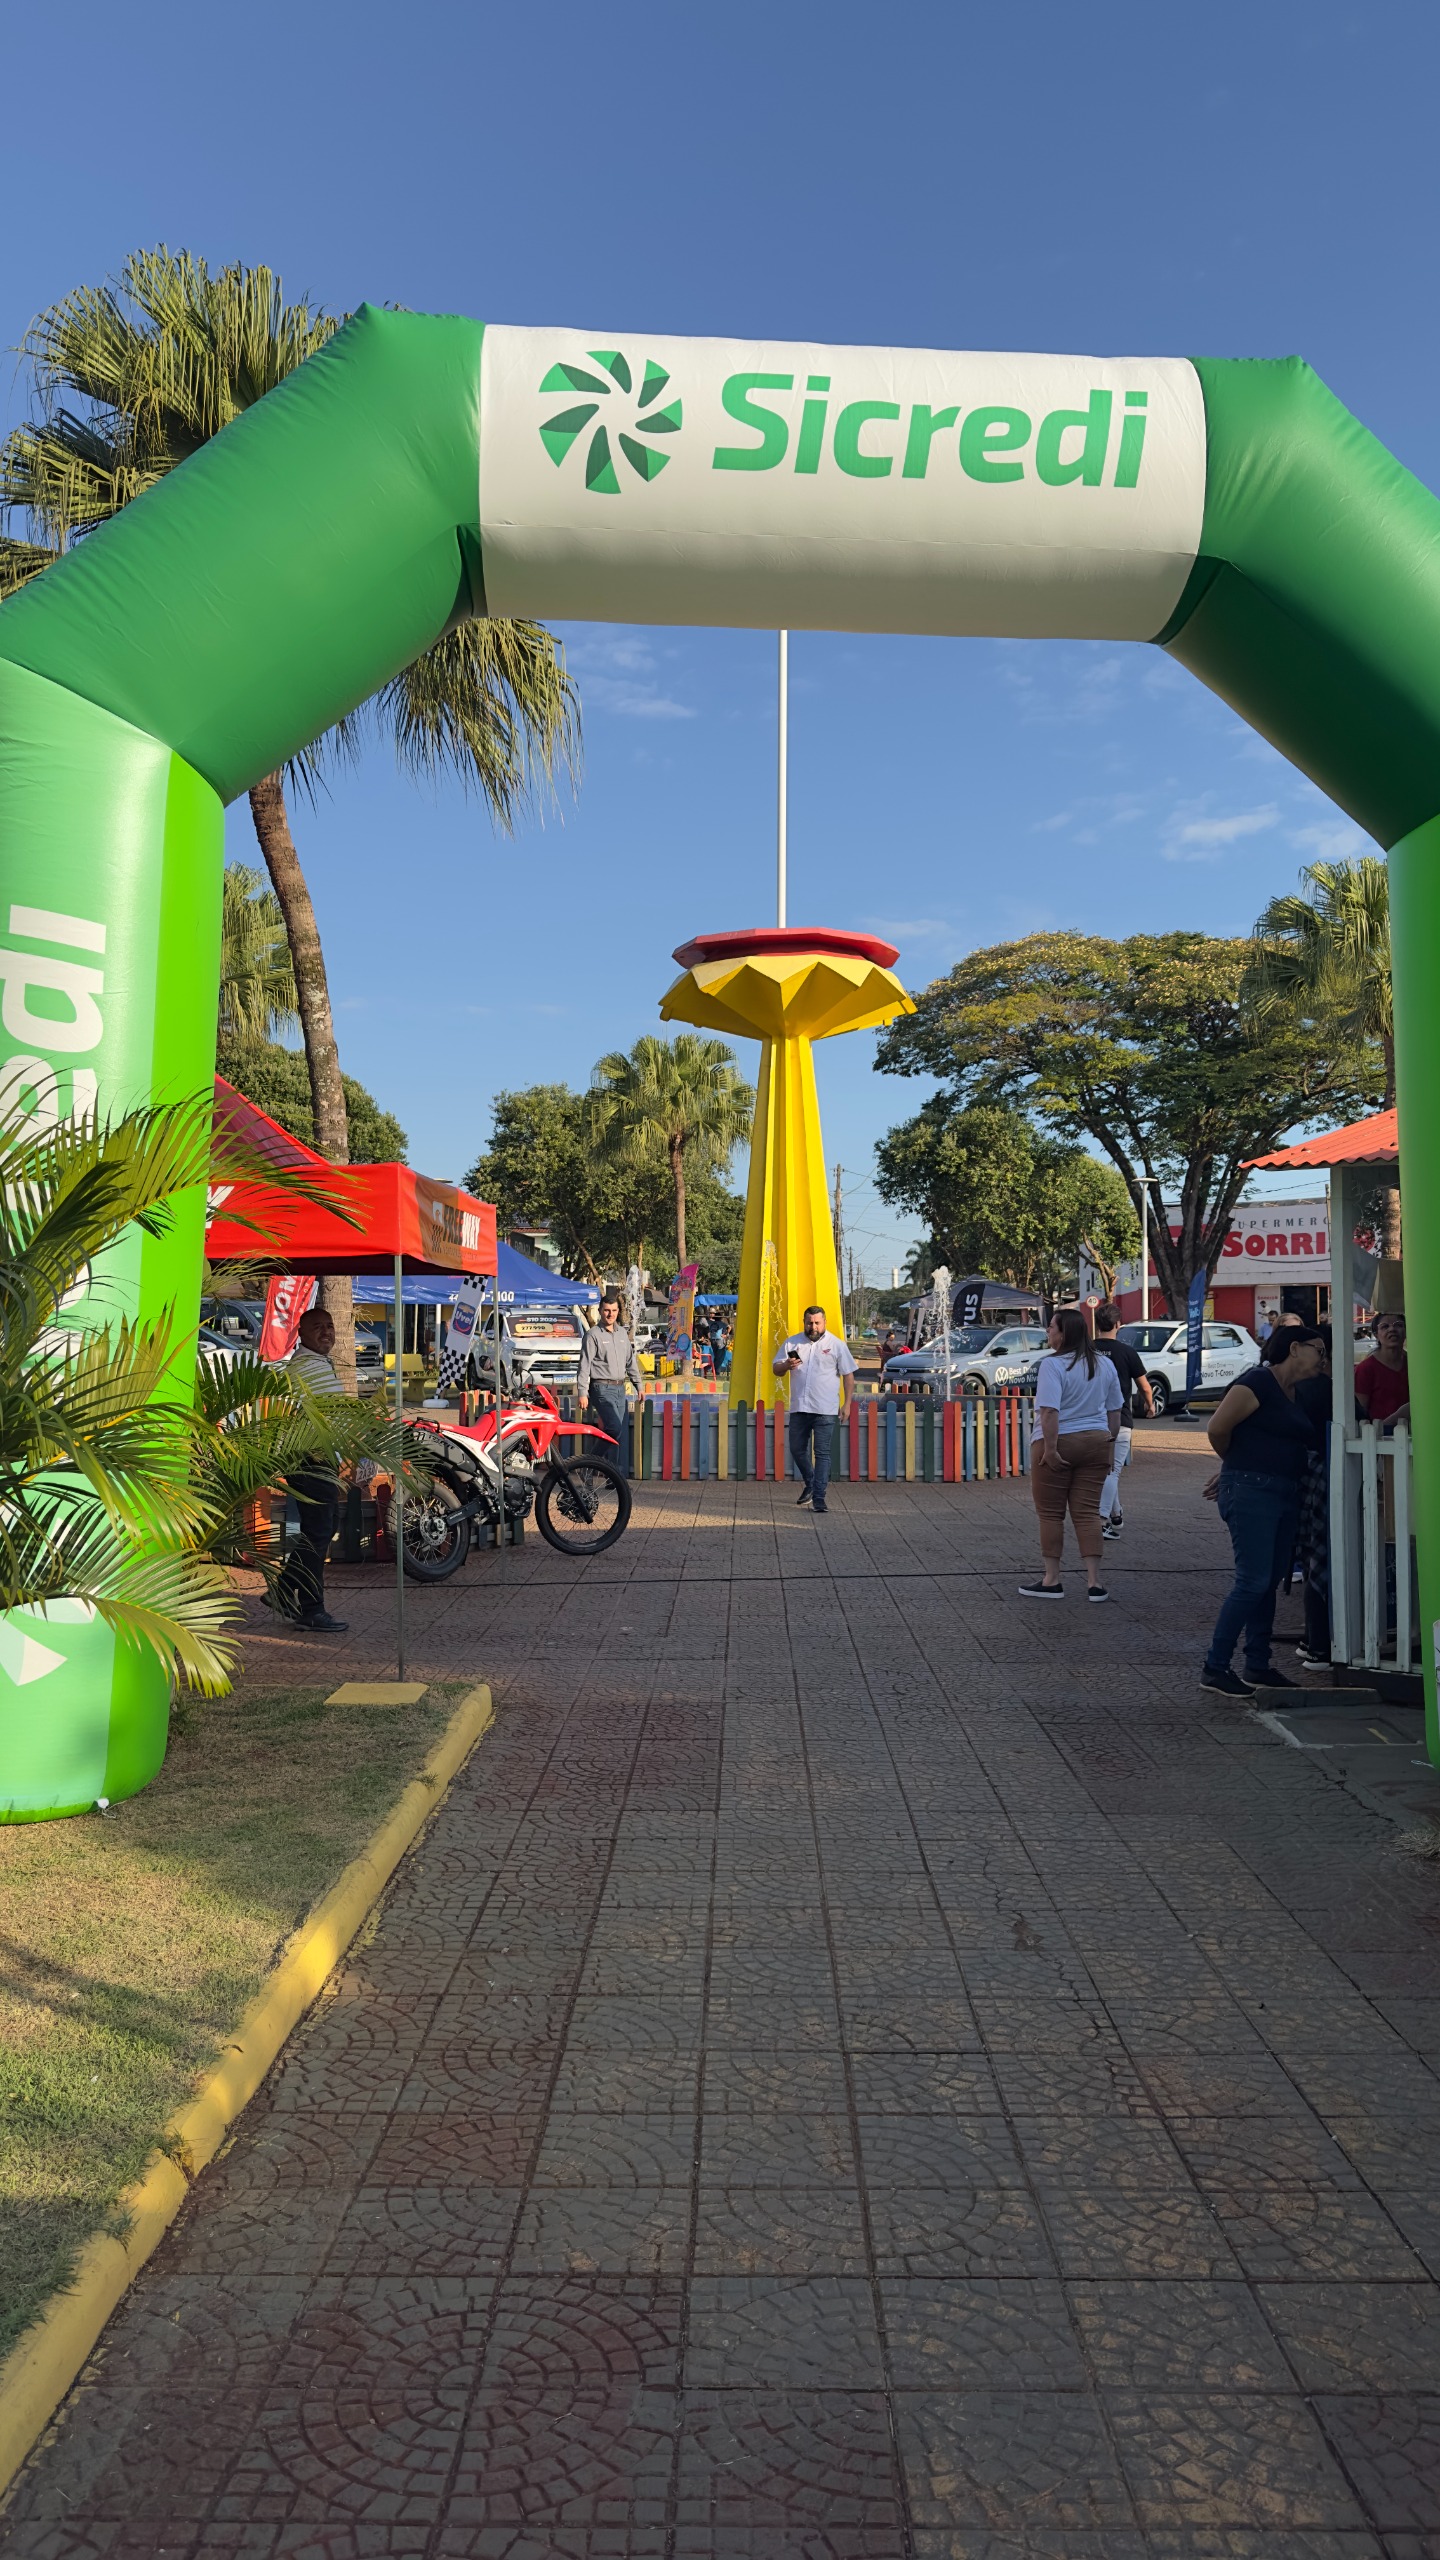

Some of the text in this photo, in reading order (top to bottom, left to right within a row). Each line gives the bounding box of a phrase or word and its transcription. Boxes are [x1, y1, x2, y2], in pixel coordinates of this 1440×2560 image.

[712, 372, 1148, 489] Sicredi
[1222, 1231, 1330, 1257] SORRI
[455, 1310, 474, 1325] Uvel
[1008, 1366, 1038, 1375] Best Drive
[1215, 1369, 1234, 1377] T-Cross
[1008, 1376, 1026, 1384] Novo
